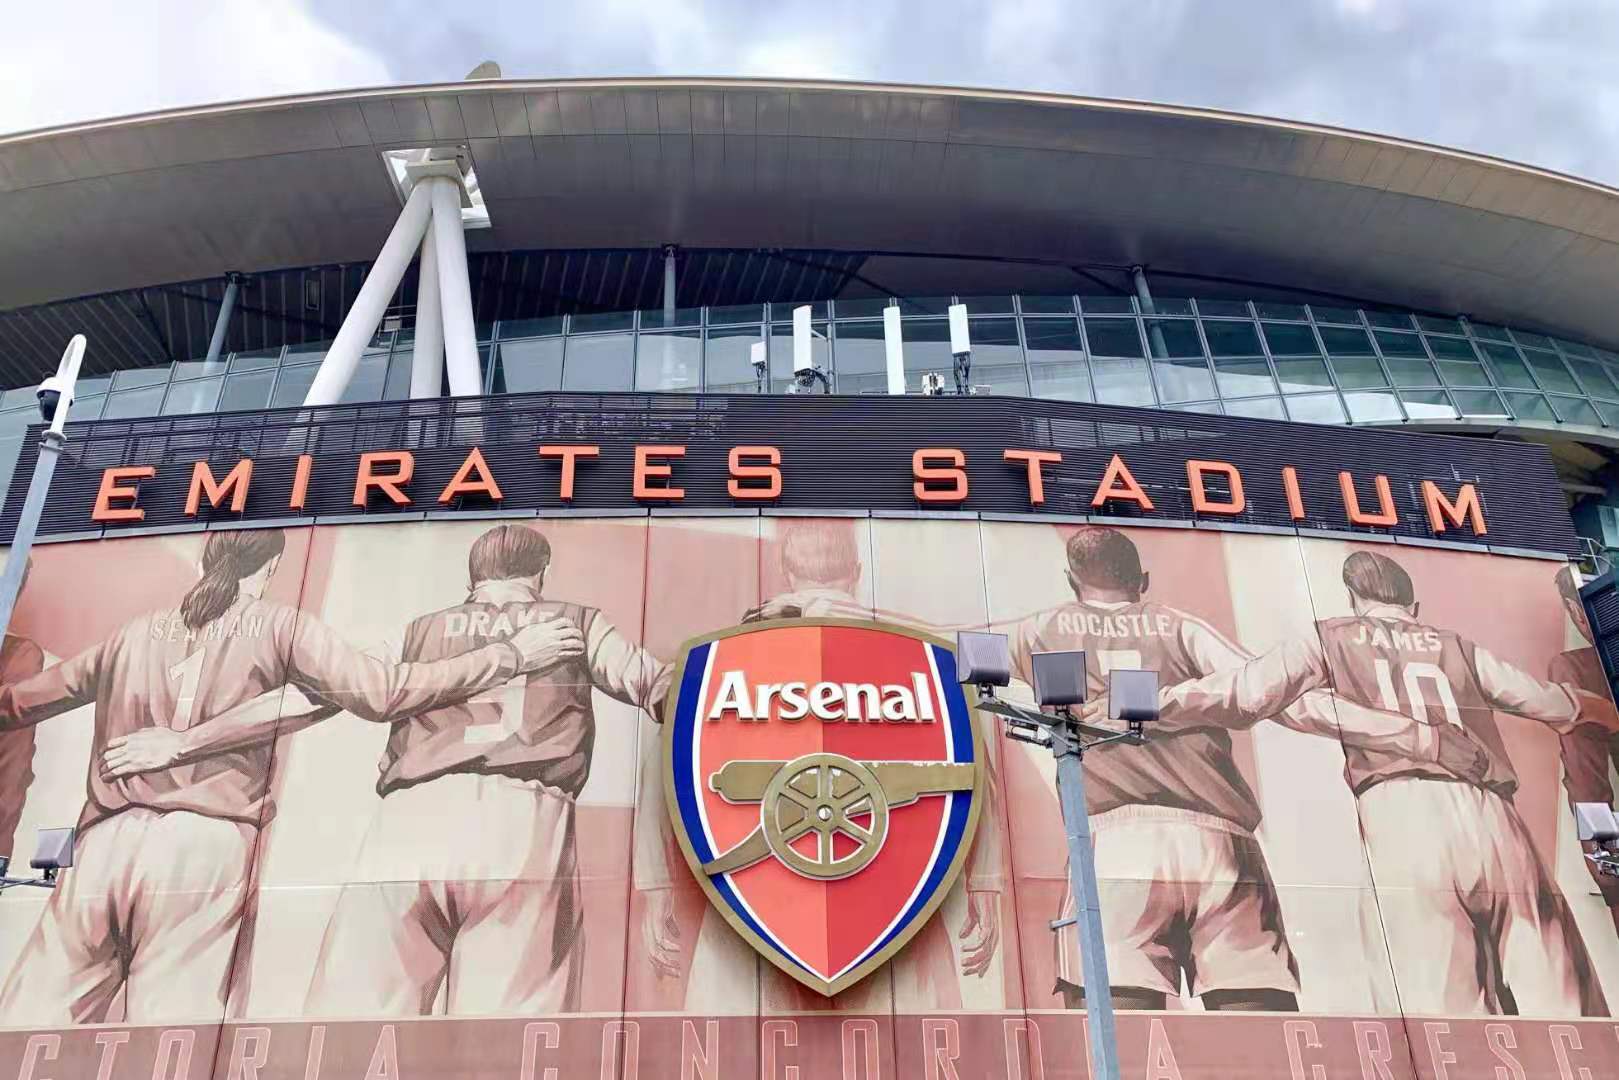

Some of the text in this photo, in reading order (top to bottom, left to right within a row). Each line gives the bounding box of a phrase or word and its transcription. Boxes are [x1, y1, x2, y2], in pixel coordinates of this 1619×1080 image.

[91, 445, 1488, 537] EMIRATES STADIUM
[1057, 612, 1173, 638] ROCASTLE
[1352, 624, 1442, 651] JAMES
[169, 647, 206, 732] 1
[708, 670, 937, 723] Arsenal
[1374, 658, 1464, 731] 10
[1283, 1019, 1619, 1080] CRESC
